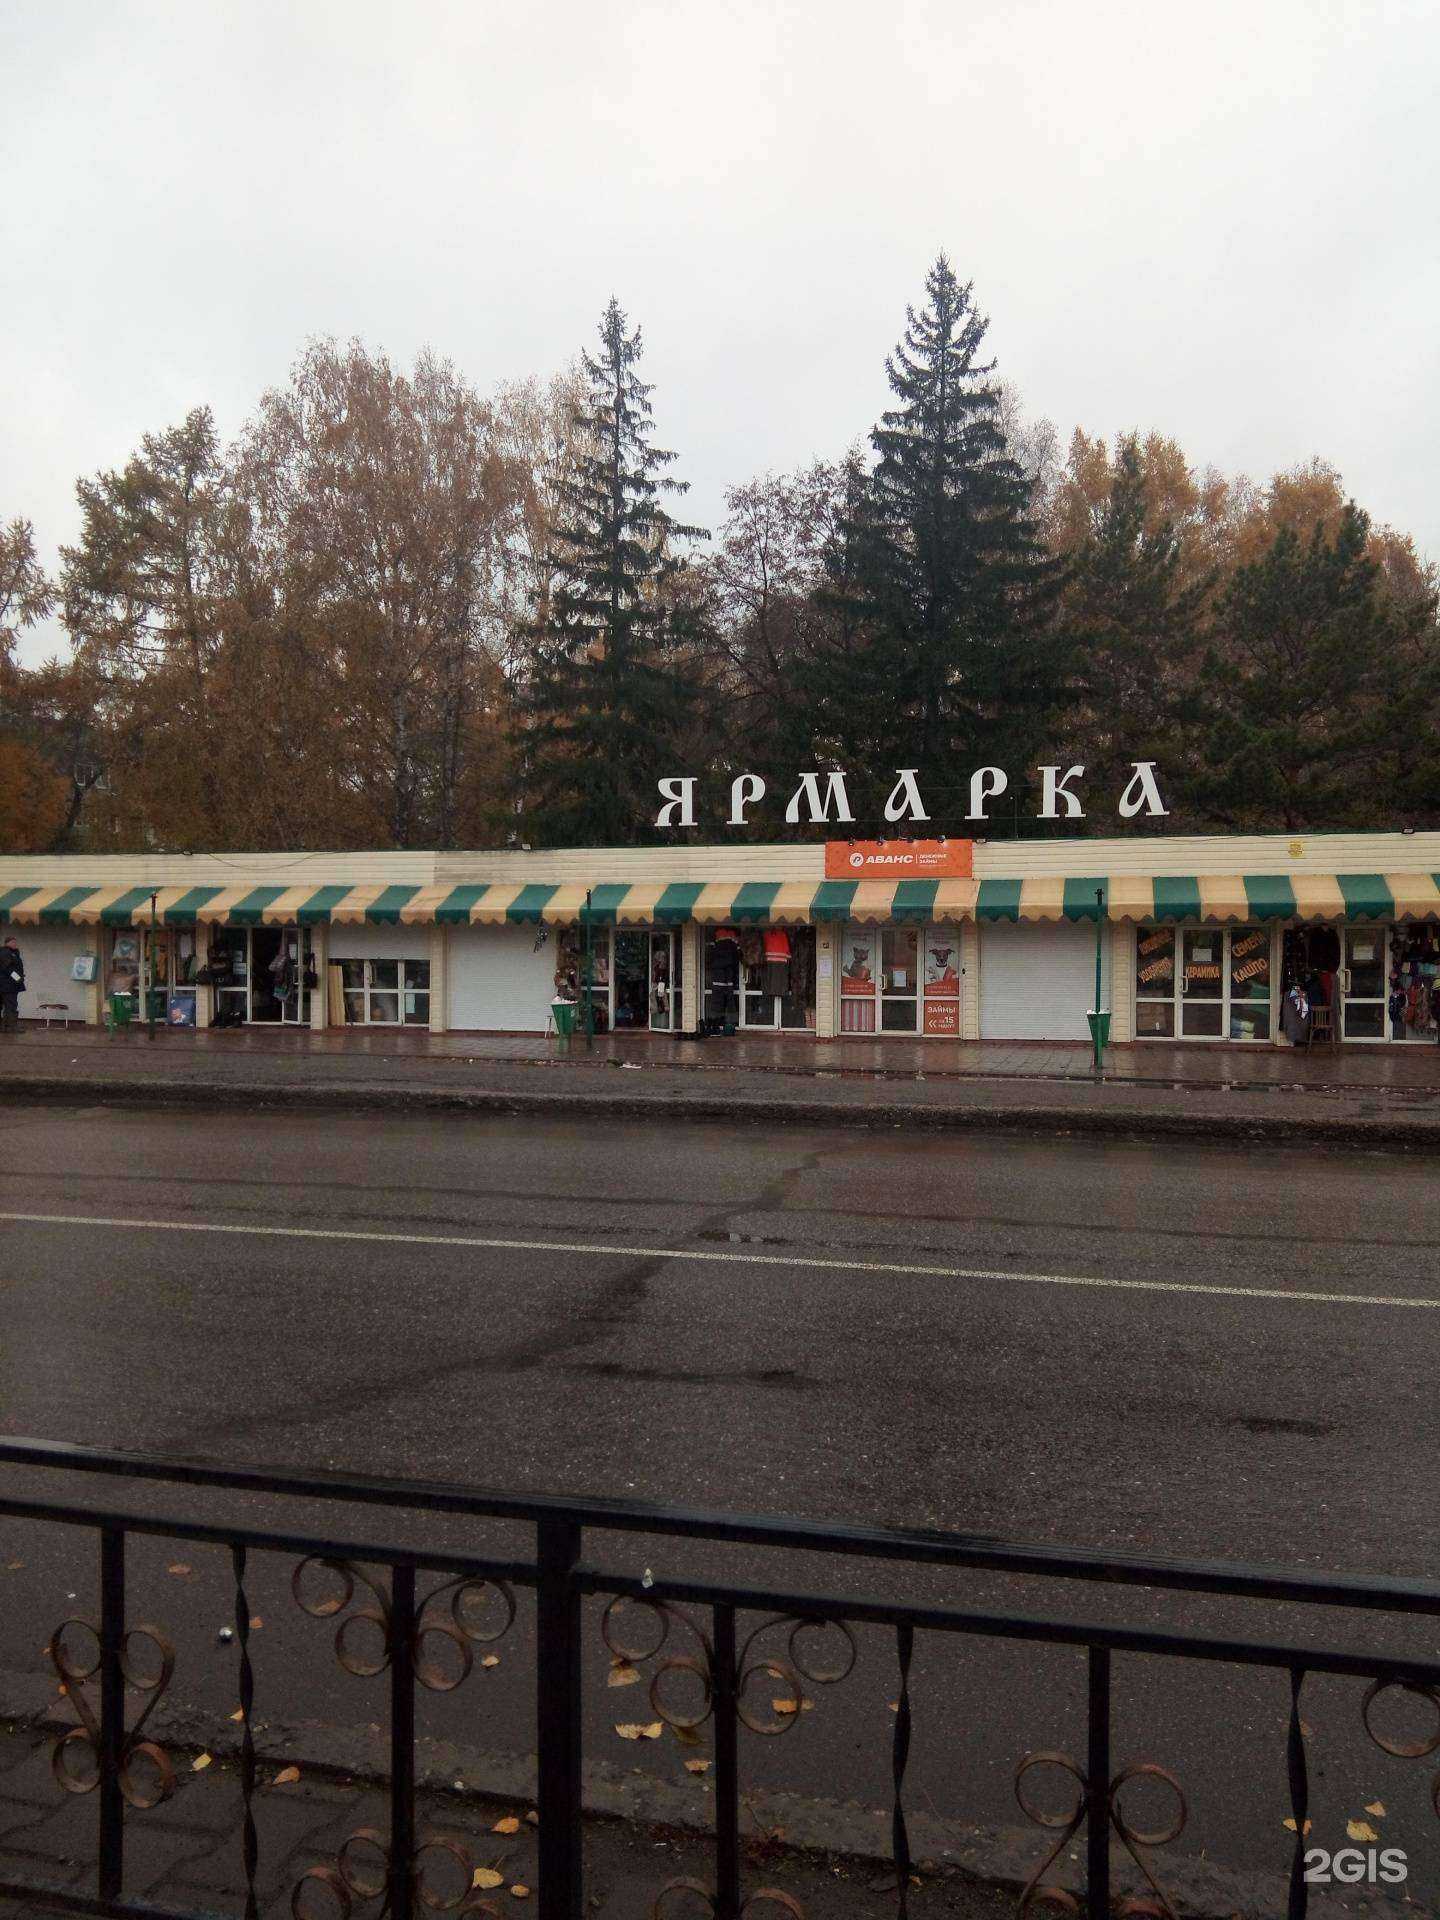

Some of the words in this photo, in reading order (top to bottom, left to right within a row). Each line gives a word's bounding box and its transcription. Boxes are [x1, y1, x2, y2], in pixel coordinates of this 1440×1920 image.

[654, 761, 1170, 827] ЯРМАРКА
[866, 854, 914, 864] АВАНС
[1185, 966, 1219, 978] КЕРАМИКА
[1231, 958, 1267, 983] КАШПО
[927, 1005, 956, 1013] ЗАЙМЫ
[944, 1016, 954, 1024] 15
